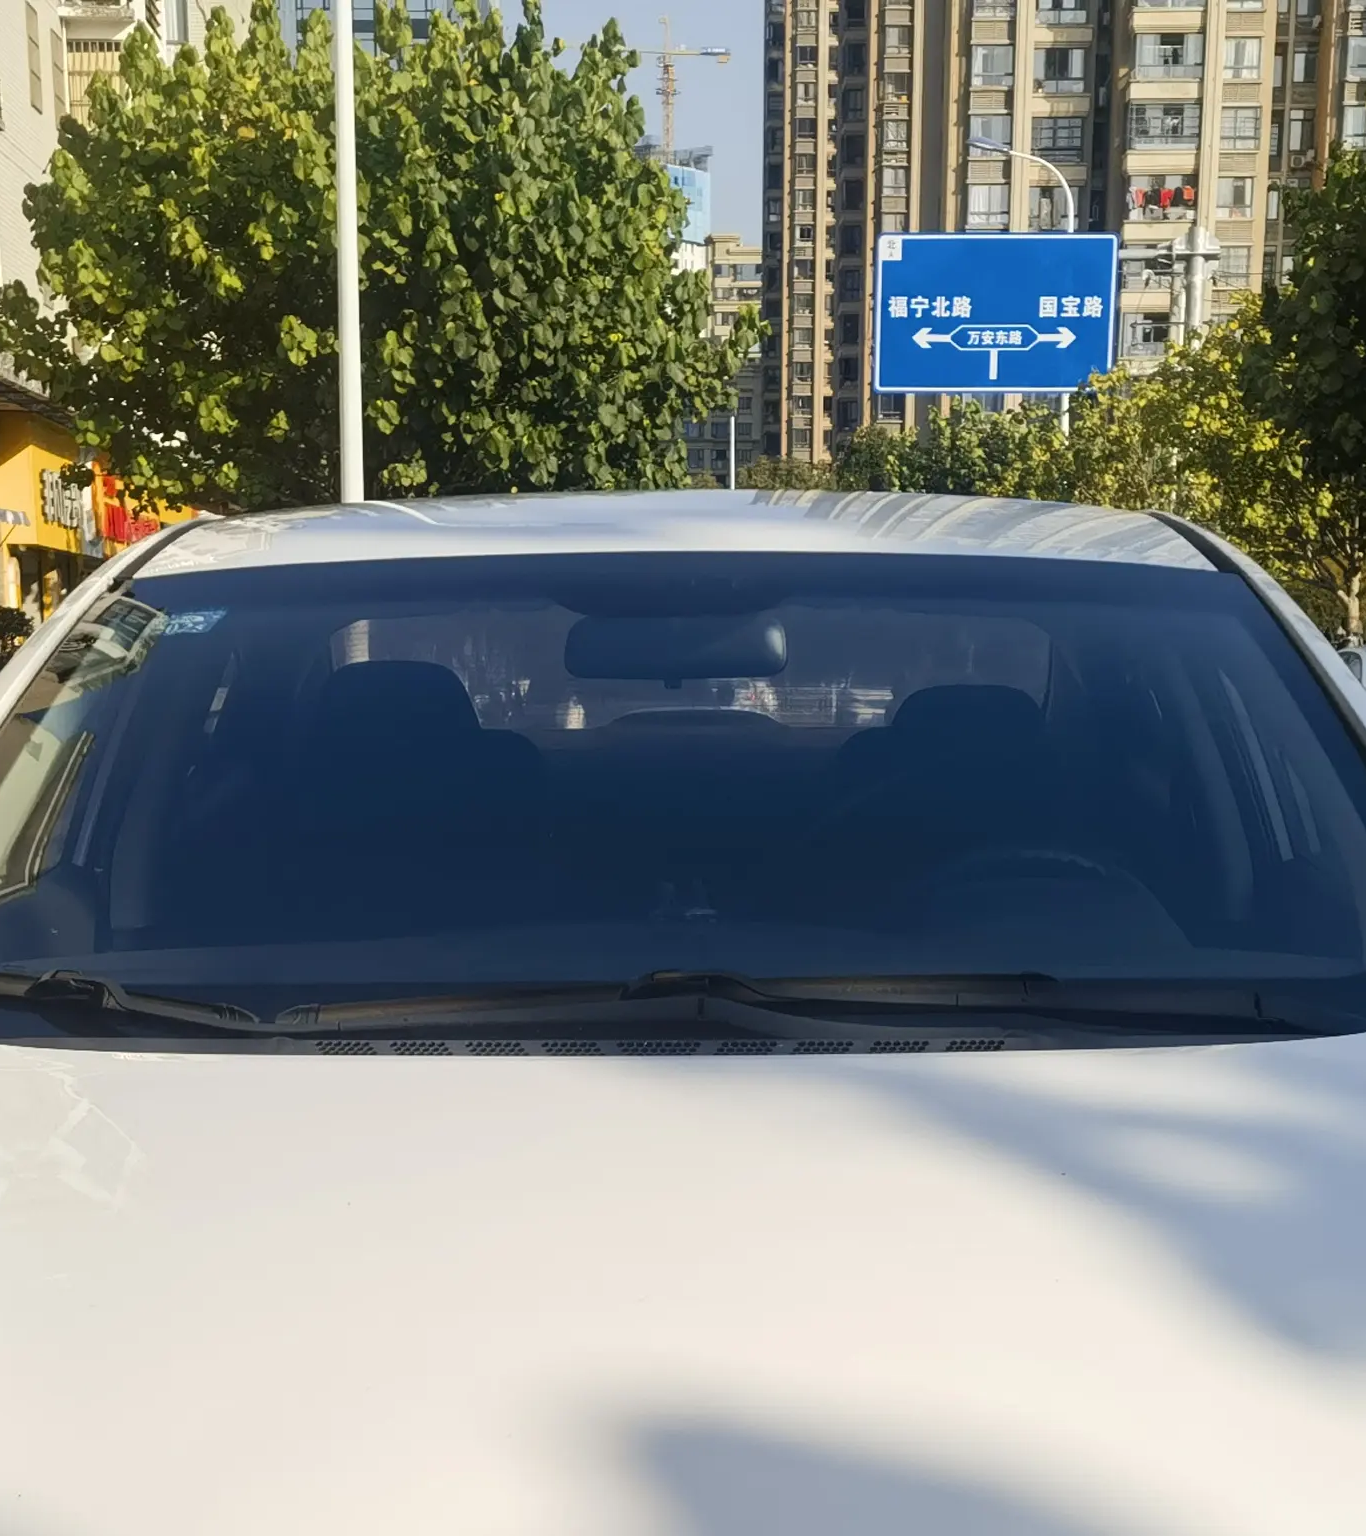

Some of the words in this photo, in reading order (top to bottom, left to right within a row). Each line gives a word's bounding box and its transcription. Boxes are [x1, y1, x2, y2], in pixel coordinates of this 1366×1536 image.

[888, 296, 972, 318] 福宁北路
[1039, 296, 1103, 318] 国宝路
[967, 330, 1023, 346] 万安东路
